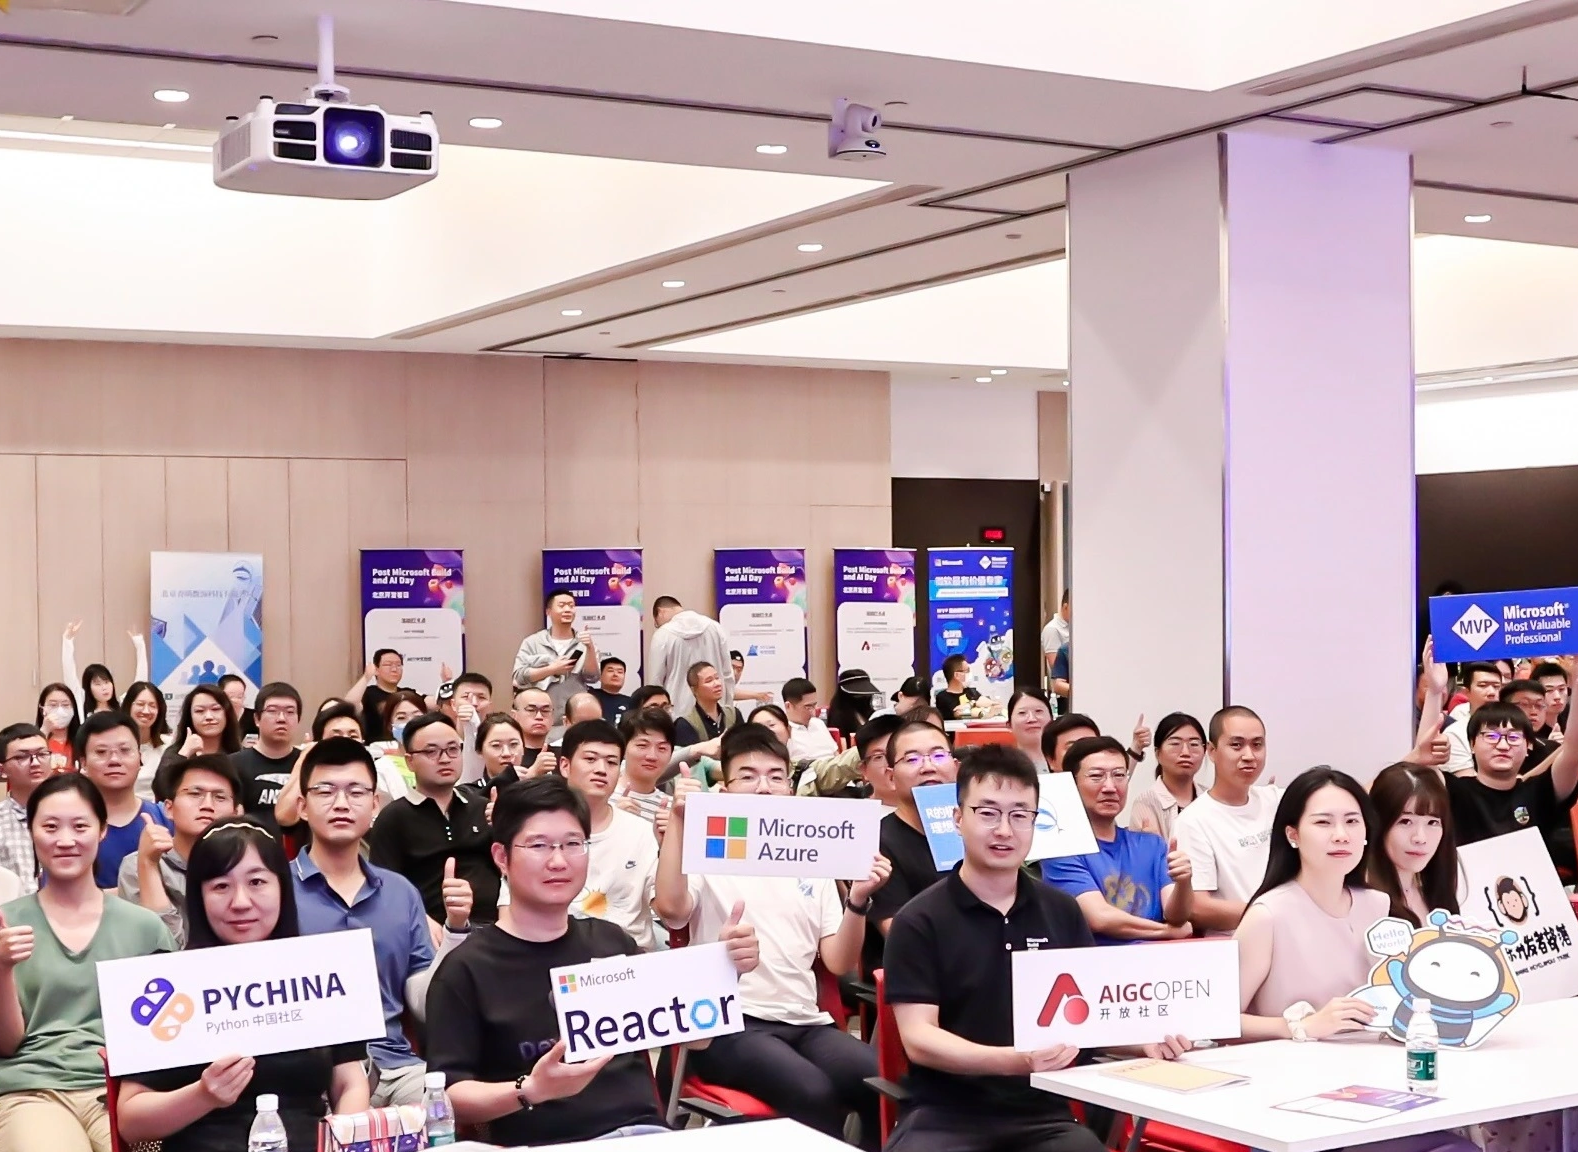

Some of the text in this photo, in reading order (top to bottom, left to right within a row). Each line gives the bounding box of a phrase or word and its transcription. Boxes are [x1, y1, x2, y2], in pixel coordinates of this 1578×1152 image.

[372, 567, 452, 577] Post Microsoft Build
[554, 566, 632, 576] Post Microsoft Build
[742, 566, 776, 574] Microsoft
[859, 566, 888, 574] Microsoft
[372, 576, 388, 584] and
[399, 577, 415, 586] Day
[580, 576, 595, 584] Day
[749, 575, 762, 583] Day
[1503, 602, 1564, 619] Microsoft
[1459, 619, 1492, 635] MVP
[1504, 619, 1571, 632] Most Valuable
[1505, 631, 1561, 645] Professional
[759, 818, 855, 840] Microsoft
[758, 843, 818, 862] Azure
[1372, 929, 1405, 942] Hello
[1376, 938, 1407, 950] World
[580, 968, 635, 987] Microsoft
[202, 972, 346, 1015] PYCHINA
[1099, 979, 1210, 1004] AIGCOPEN
[1100, 1005, 1169, 1020] 开放社区
[206, 1009, 303, 1035] Python 中国社区
[565, 994, 734, 1052] Reactor
